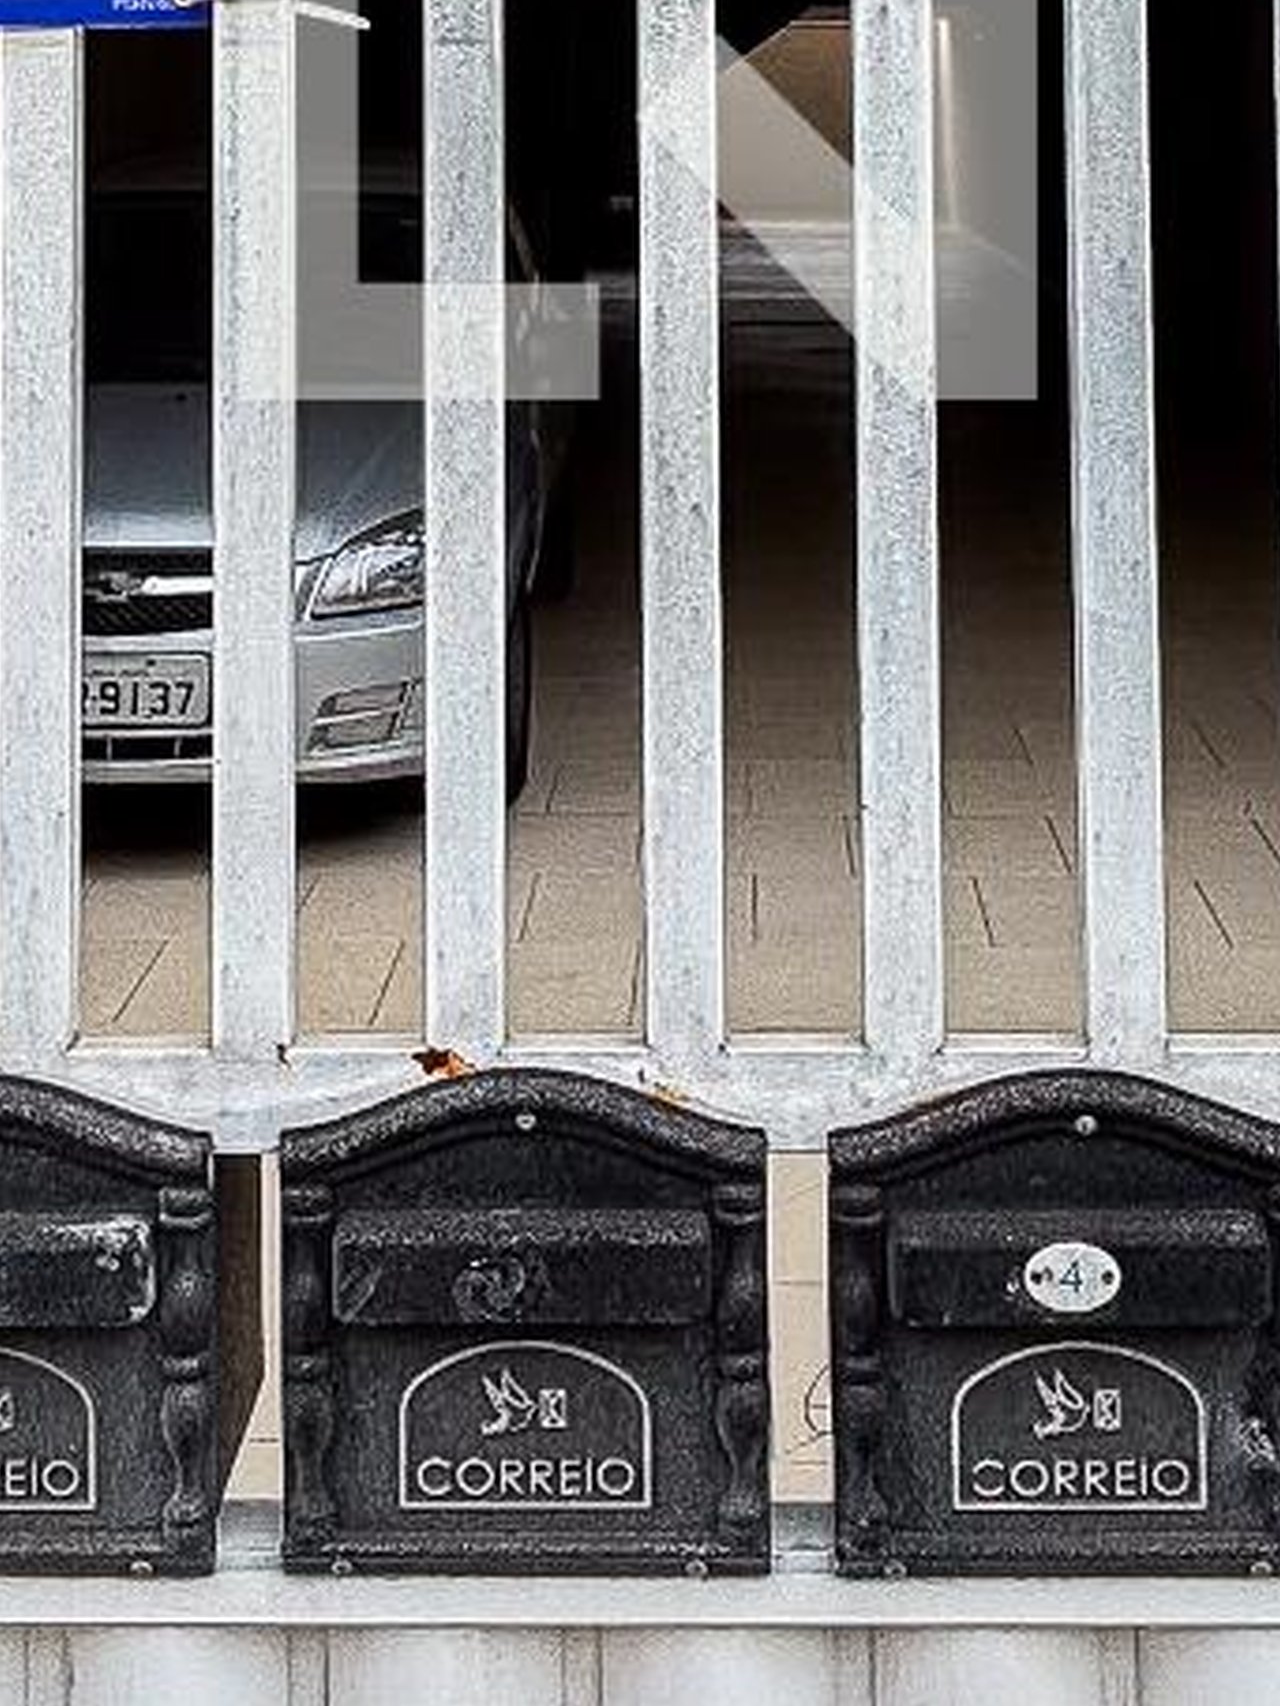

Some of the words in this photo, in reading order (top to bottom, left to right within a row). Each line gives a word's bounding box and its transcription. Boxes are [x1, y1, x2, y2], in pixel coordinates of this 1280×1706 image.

[1059, 1259, 1083, 1294] 4
[416, 1455, 637, 1499] CORREIO
[972, 1456, 1190, 1499] CORREIO
